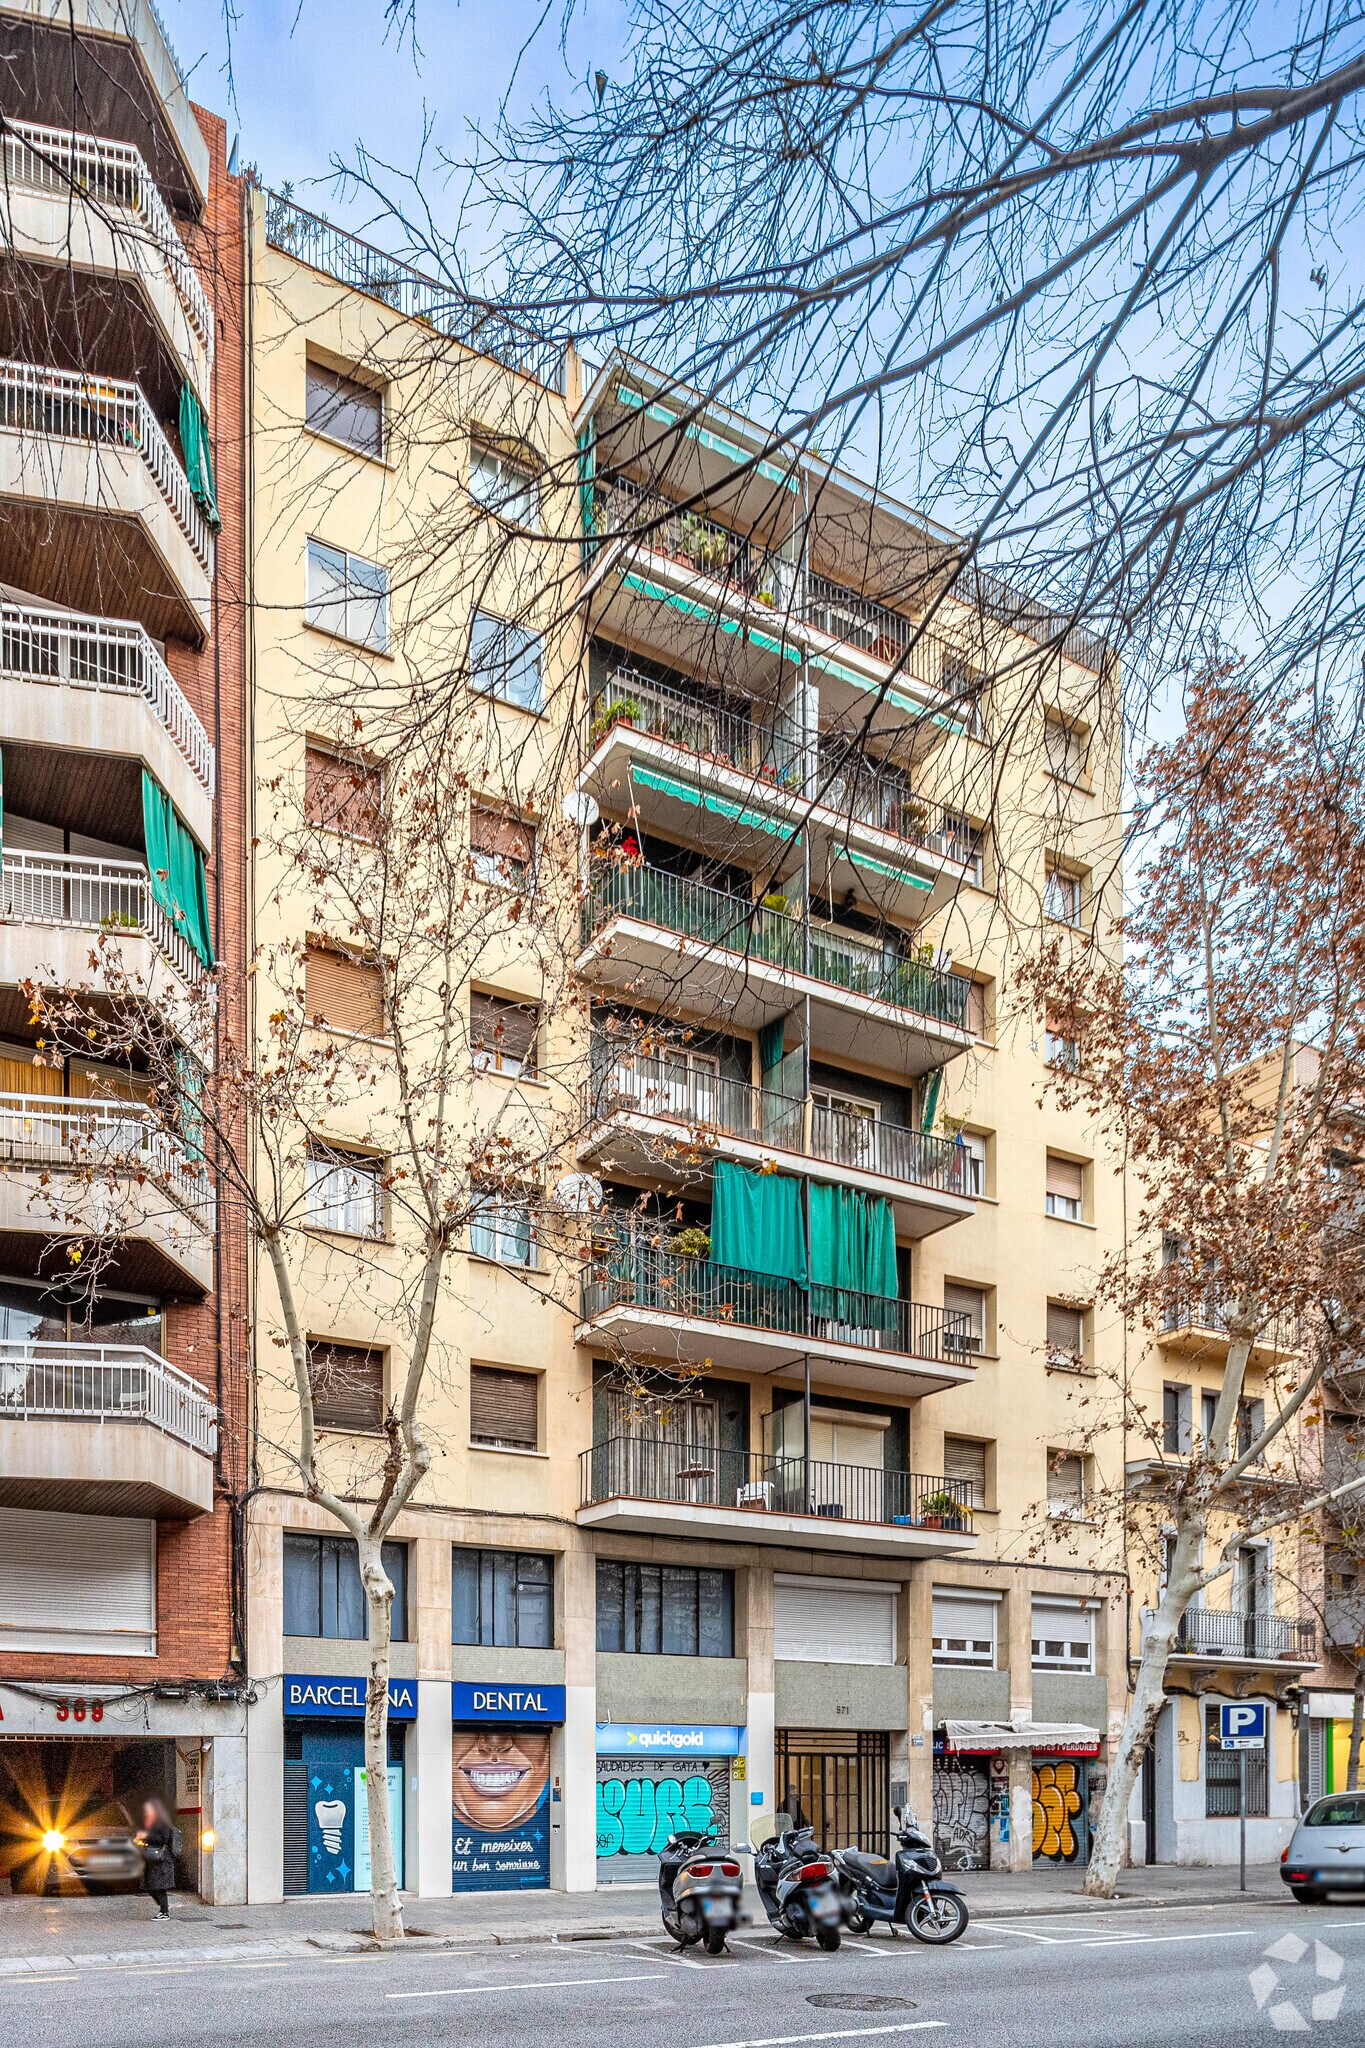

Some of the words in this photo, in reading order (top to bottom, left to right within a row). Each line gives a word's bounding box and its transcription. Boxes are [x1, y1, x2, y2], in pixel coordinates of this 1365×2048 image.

[290, 1684, 413, 1708] BARCELNA
[473, 1691, 548, 1711] DENTAL
[1229, 1707, 1257, 1735] P
[639, 1731, 703, 1748] quickgold
[653, 1760, 667, 1772] DE
[672, 1762, 698, 1772] GATA
[454, 1837, 473, 1855] Et
[452, 1860, 468, 1872] un
[472, 1858, 491, 1872] bon
